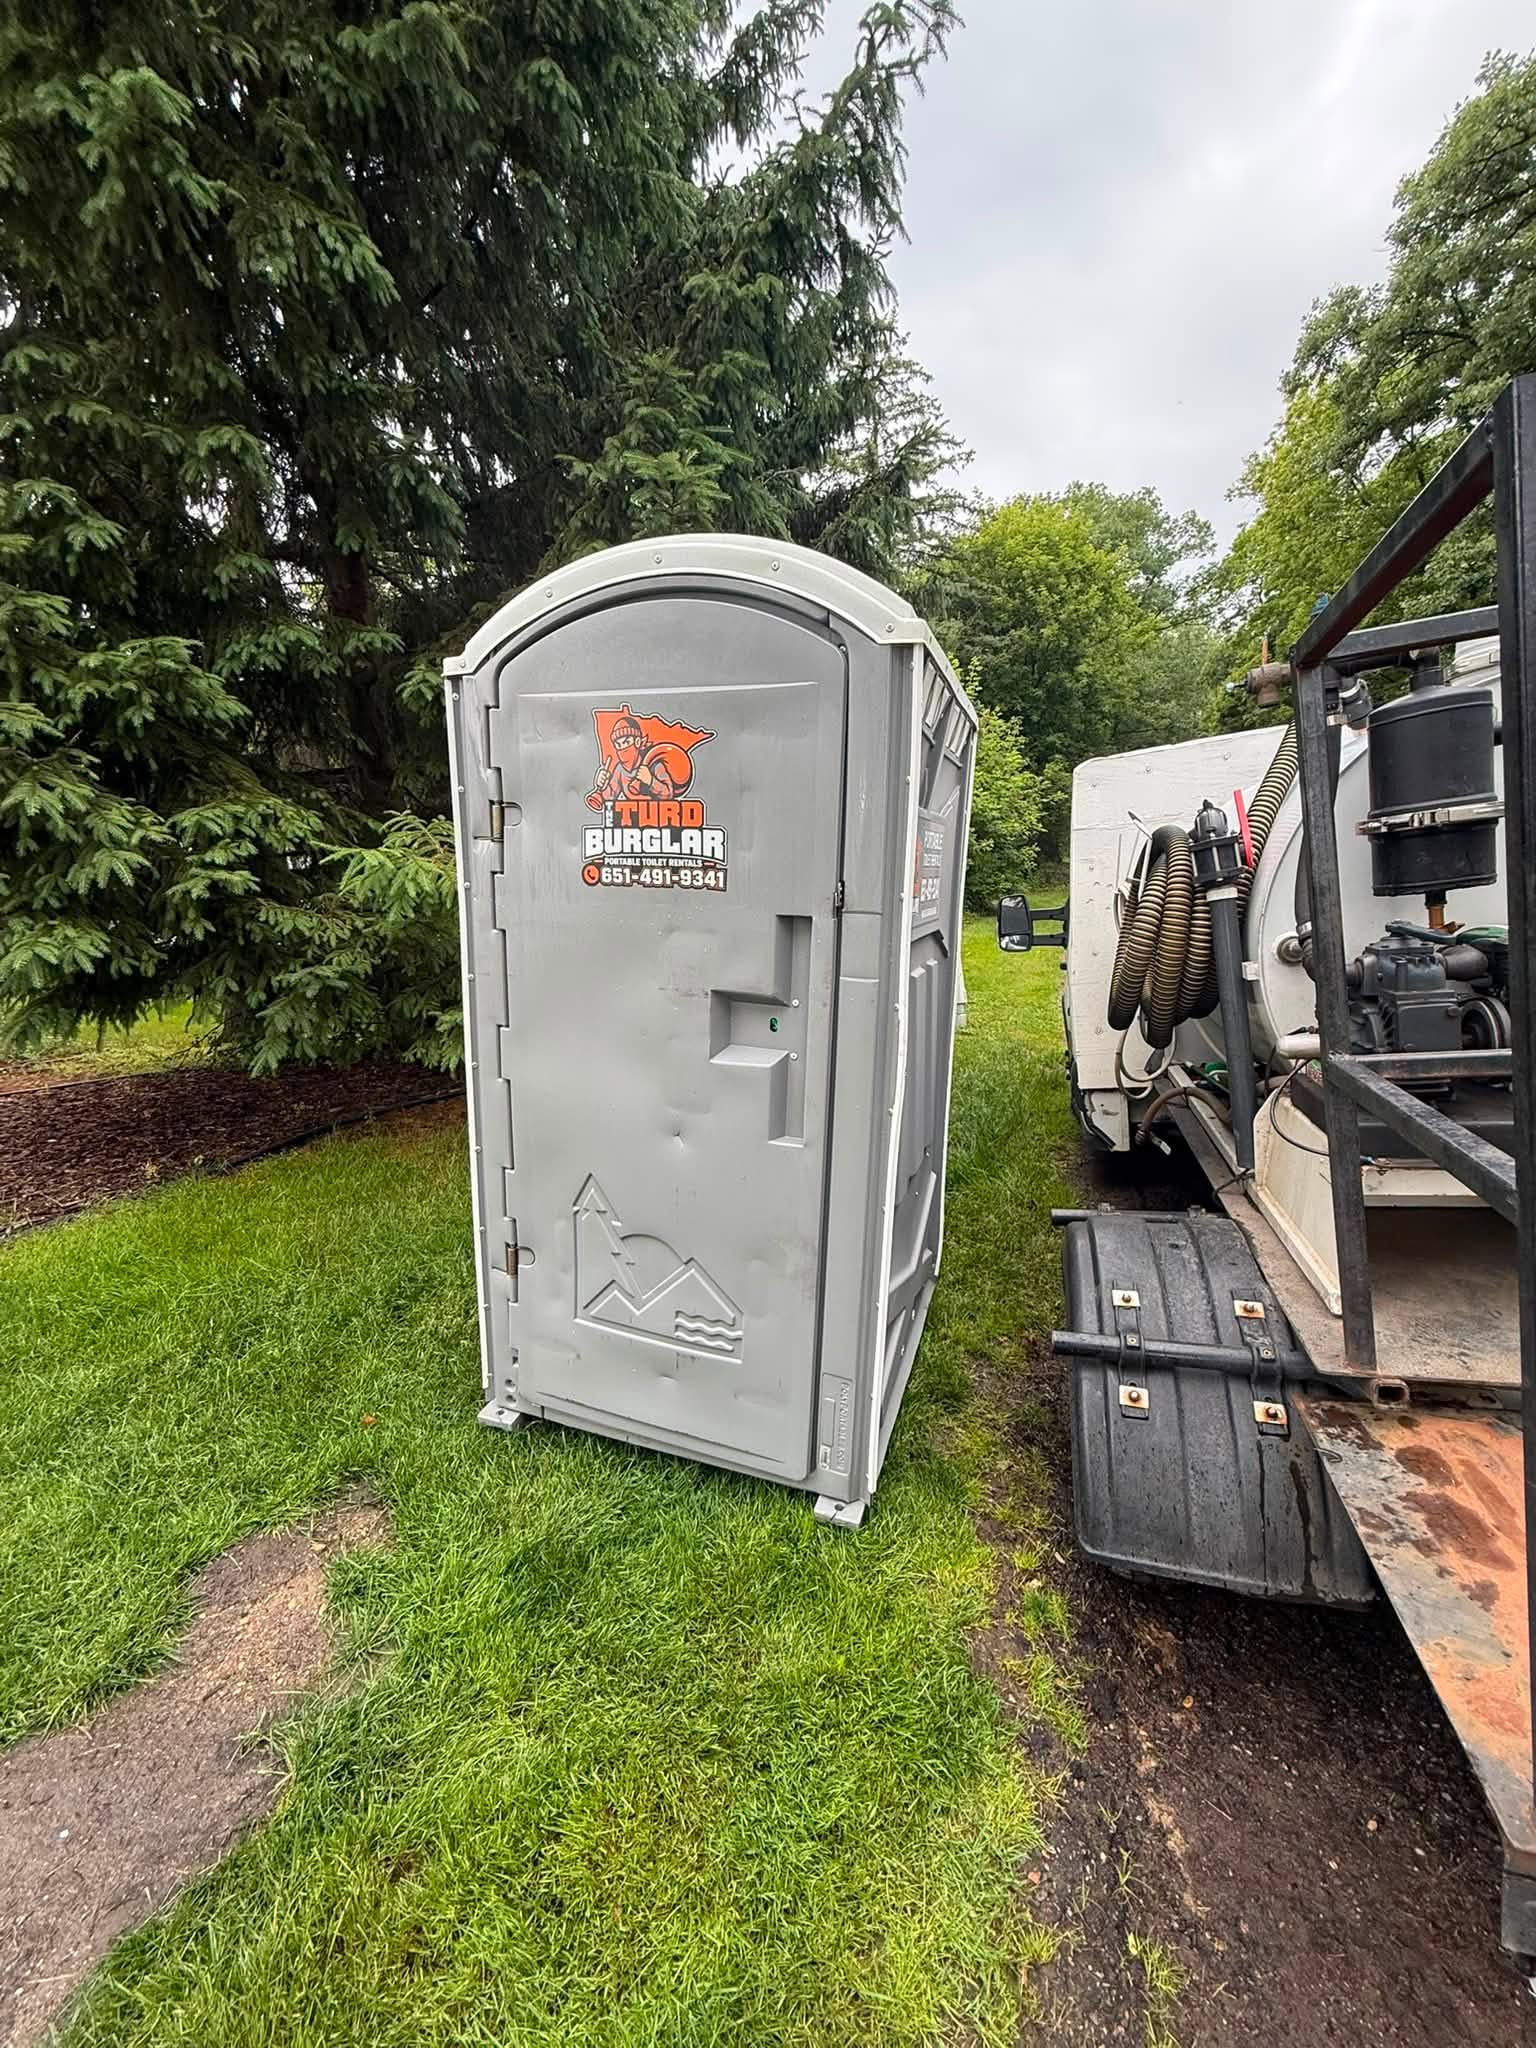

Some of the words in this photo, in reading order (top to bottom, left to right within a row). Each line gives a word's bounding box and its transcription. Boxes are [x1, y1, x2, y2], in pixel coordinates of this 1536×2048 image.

[615, 800, 703, 828] TURD
[584, 828, 725, 861] BURGLAR
[604, 857, 641, 866] PORTABLE
[642, 858, 668, 867] TOILET
[668, 859, 703, 868] RENTALS
[602, 867, 724, 888] 651-491-9341
